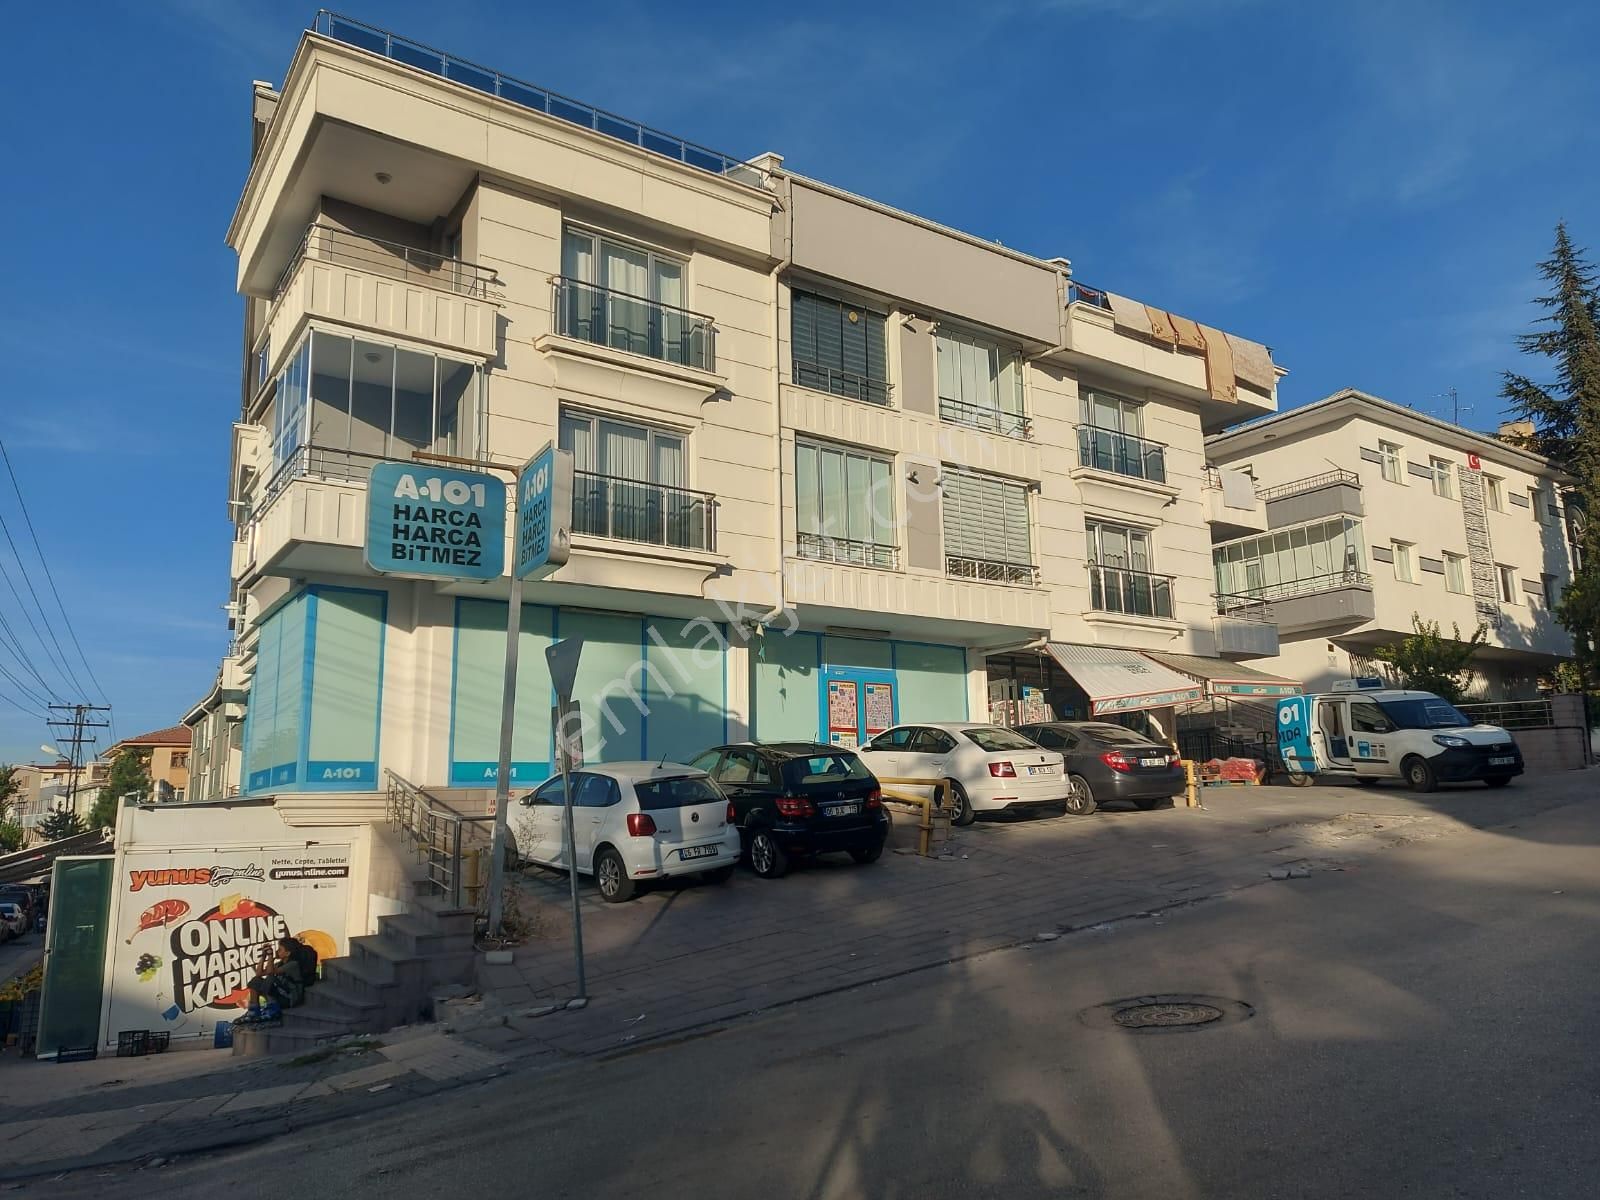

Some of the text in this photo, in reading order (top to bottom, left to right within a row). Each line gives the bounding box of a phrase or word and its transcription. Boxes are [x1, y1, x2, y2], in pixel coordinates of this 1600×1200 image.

[393, 504, 482, 529] HARCA
[523, 496, 547, 528] HARCA
[392, 524, 481, 548] HARCA
[522, 516, 546, 547] HARCA
[129, 868, 211, 892] yunus
[180, 914, 286, 956] ONLINE
